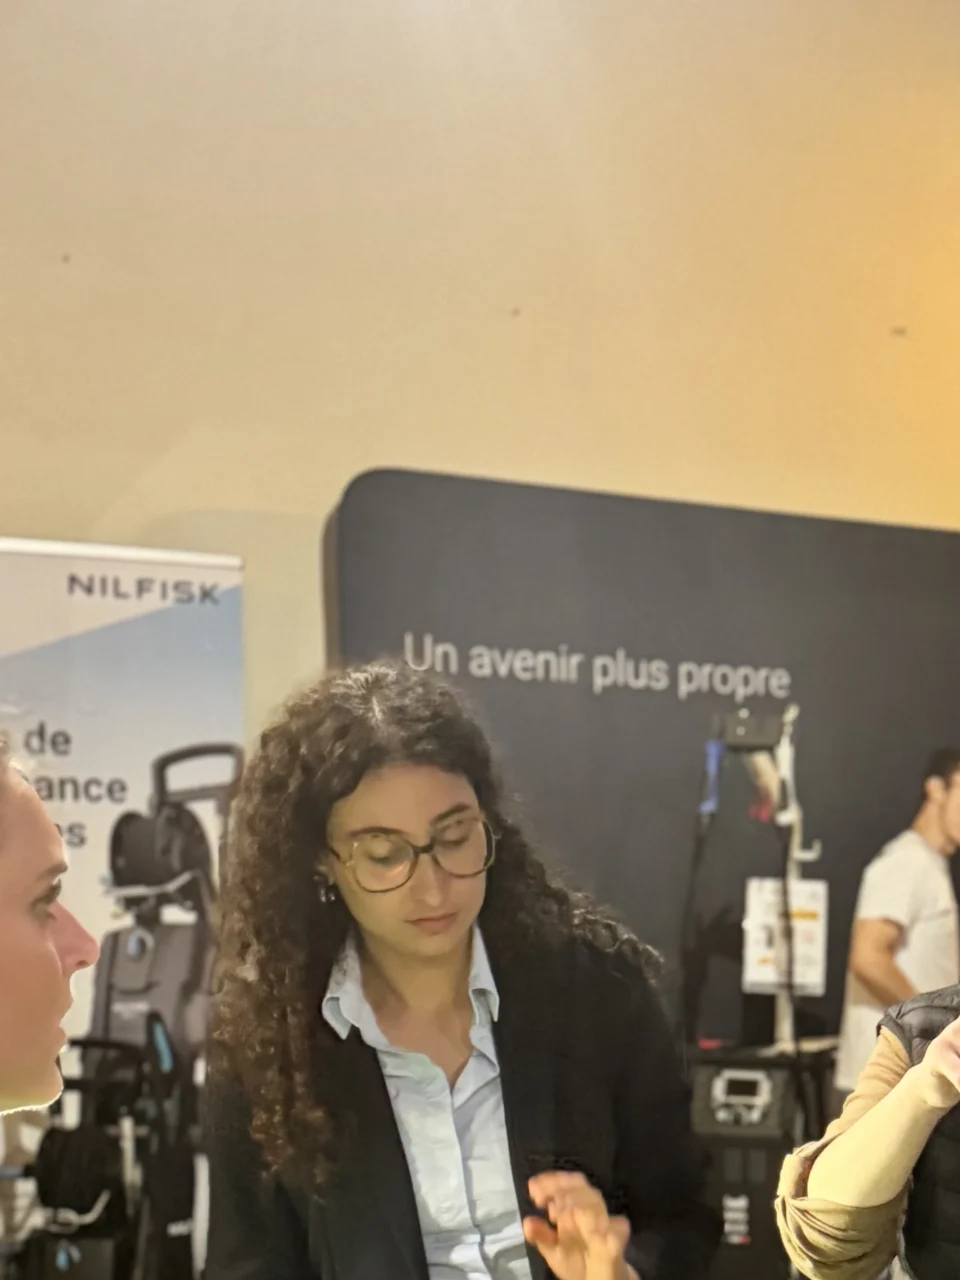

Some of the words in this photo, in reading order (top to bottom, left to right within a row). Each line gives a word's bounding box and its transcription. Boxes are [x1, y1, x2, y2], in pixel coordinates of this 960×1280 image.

[67, 573, 220, 606] NILFISK
[403, 632, 459, 675] Un
[468, 643, 585, 683] avenir
[592, 647, 670, 695] plus
[678, 660, 792, 704] propre
[23, 719, 72, 757] de
[24, 775, 128, 804] ance
